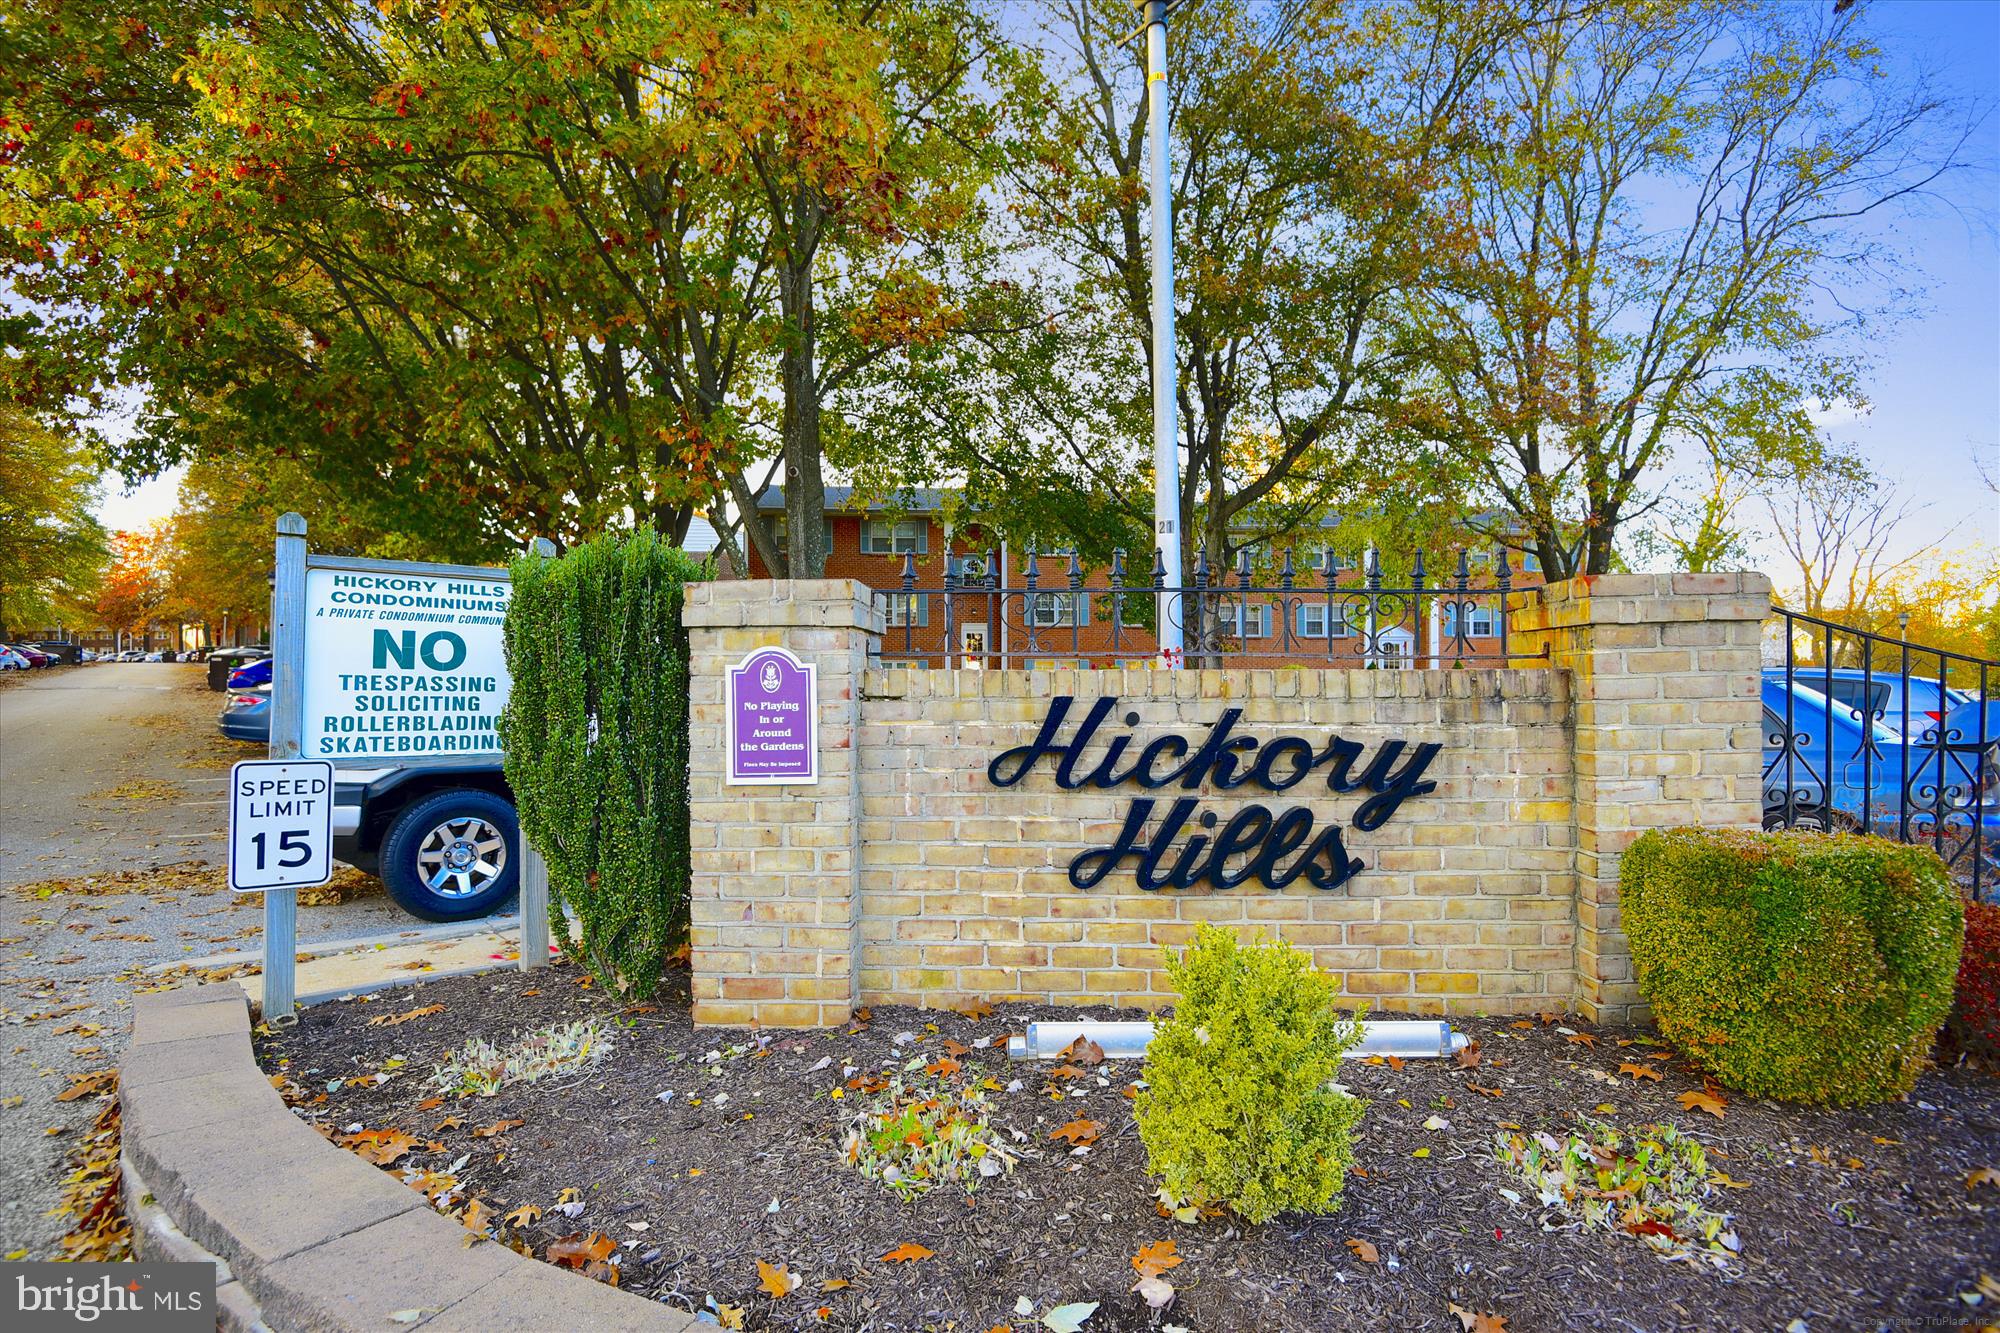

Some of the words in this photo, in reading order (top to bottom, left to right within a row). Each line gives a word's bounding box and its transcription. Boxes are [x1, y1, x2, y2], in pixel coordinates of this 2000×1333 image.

[1159, 520, 1175, 534] 21
[334, 575, 437, 593] HICKORY
[448, 583, 505, 597] HILLS
[330, 591, 506, 613] CONDOMINIUMS
[316, 608, 324, 617] A
[329, 608, 375, 619] PRIVATE
[379, 611, 455, 623] CONDOMINIUM
[372, 629, 467, 671] NO
[339, 674, 496, 692] TRESPASSING
[355, 695, 480, 712] SOLICITING
[744, 702, 758, 711] No
[761, 701, 800, 712] Playing
[759, 715, 770, 723] In
[753, 728, 791, 737] Around
[740, 742, 757, 751] the
[761, 742, 804, 751] Gardens
[987, 696, 1443, 832] Hickory
[241, 779, 326, 797] SPEED
[250, 800, 316, 819] LIMIT
[251, 829, 313, 870] 15
[1068, 796, 1365, 891] Hills
